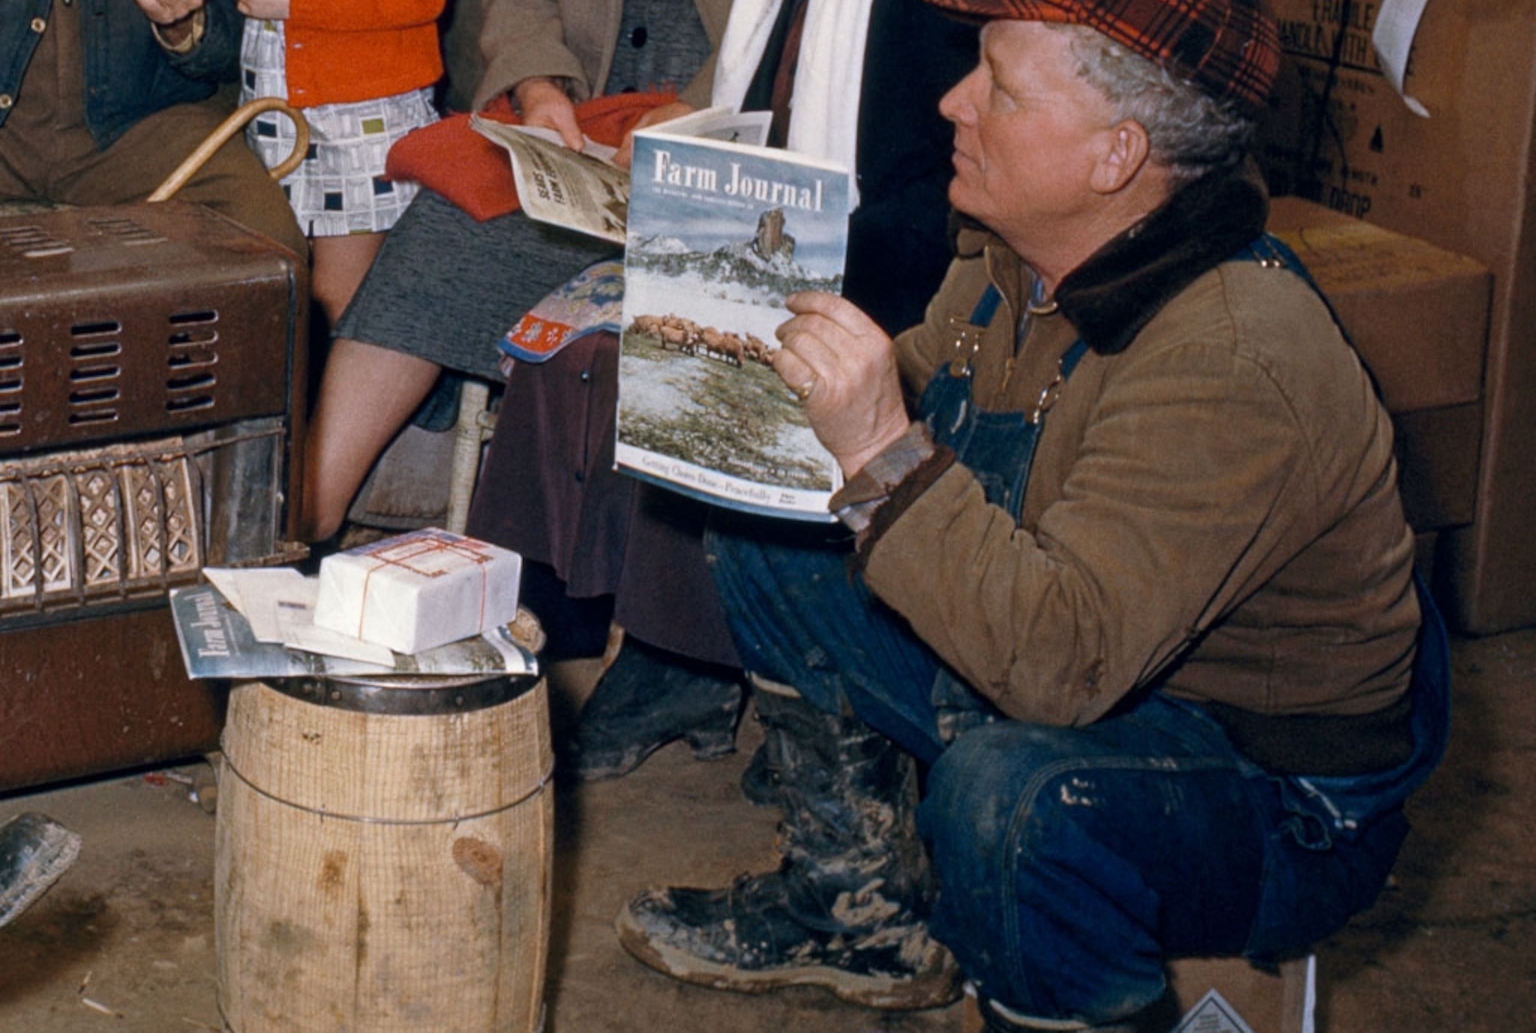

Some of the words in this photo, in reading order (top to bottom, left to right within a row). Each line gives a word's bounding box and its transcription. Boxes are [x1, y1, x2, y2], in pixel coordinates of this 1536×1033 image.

[652, 148, 718, 193] Farm
[724, 161, 824, 213] Journal
[183, 590, 222, 628] Journal
[198, 627, 231, 659] Farm
